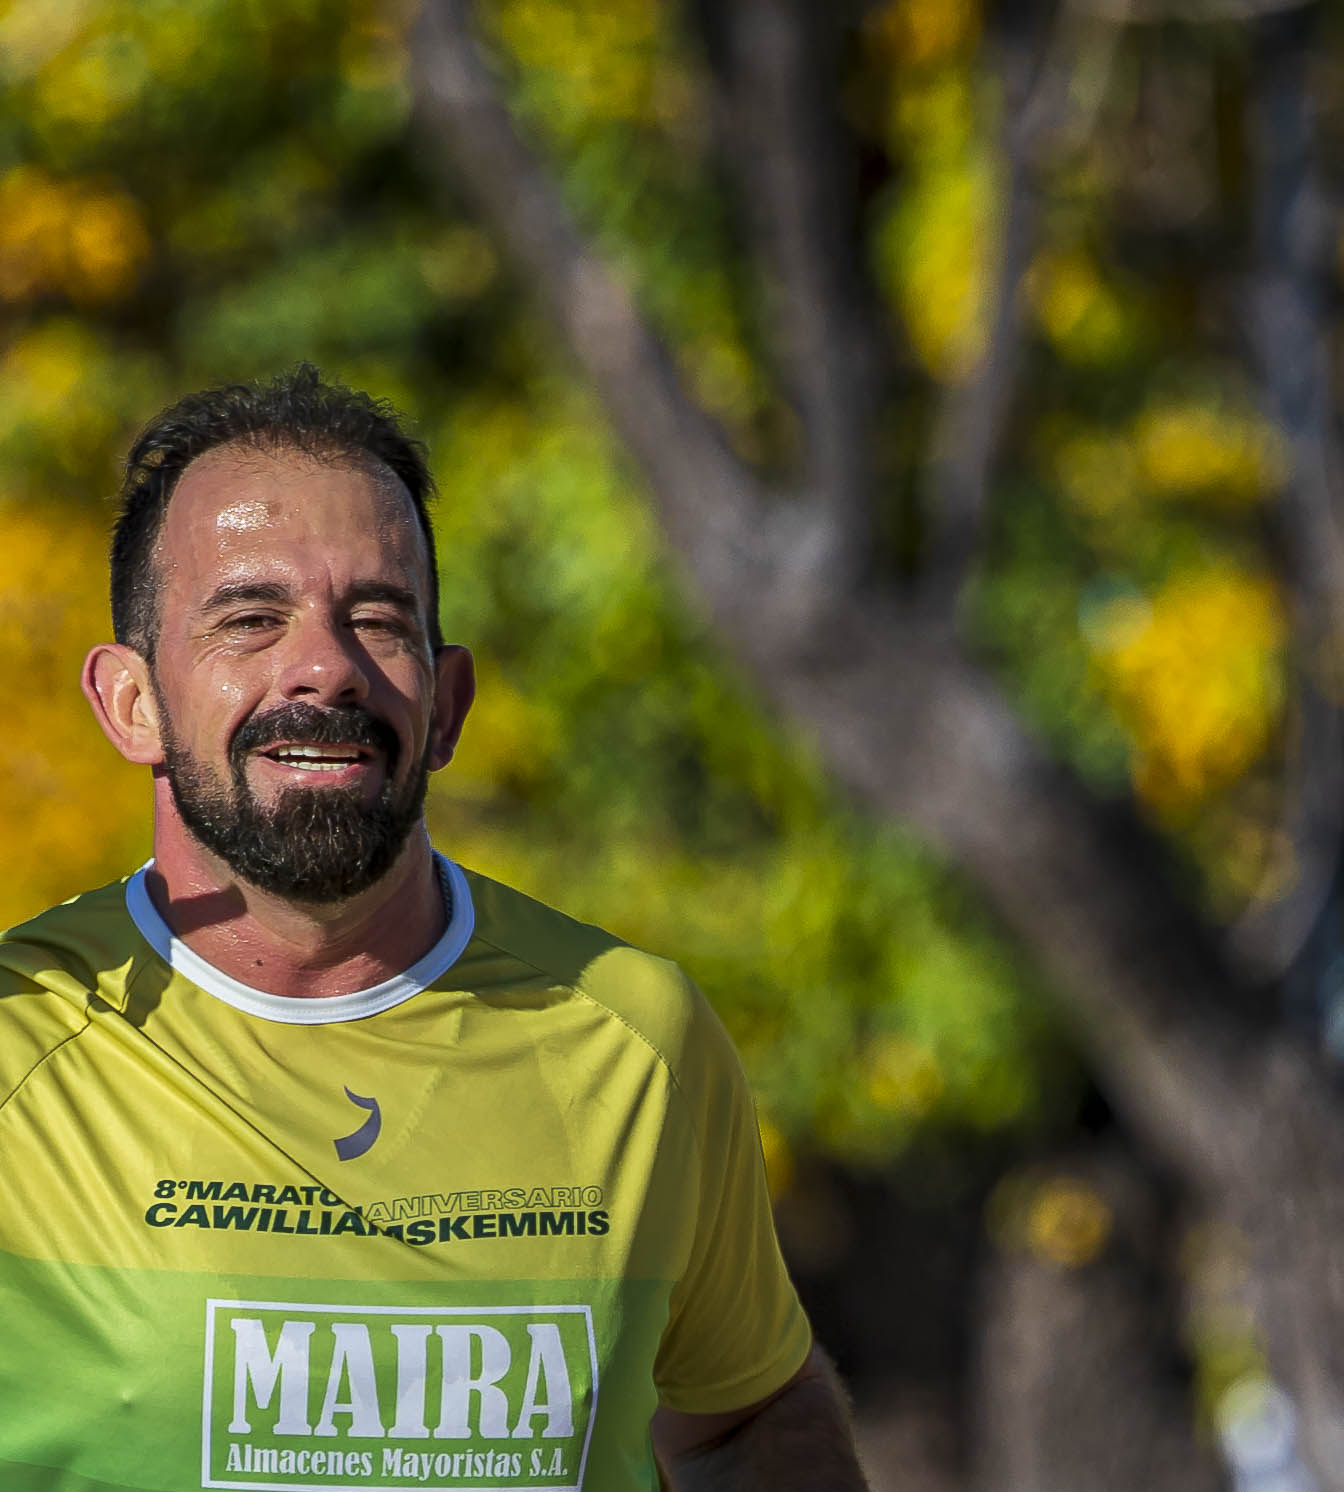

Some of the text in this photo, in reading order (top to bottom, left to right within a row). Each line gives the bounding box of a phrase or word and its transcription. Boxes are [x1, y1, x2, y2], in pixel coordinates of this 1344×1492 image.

[364, 1186, 604, 1223] ANIVERSARIO
[227, 1318, 575, 1440] MAIRA
[225, 1443, 569, 1482] Almacenes Mayoristas S.A.
